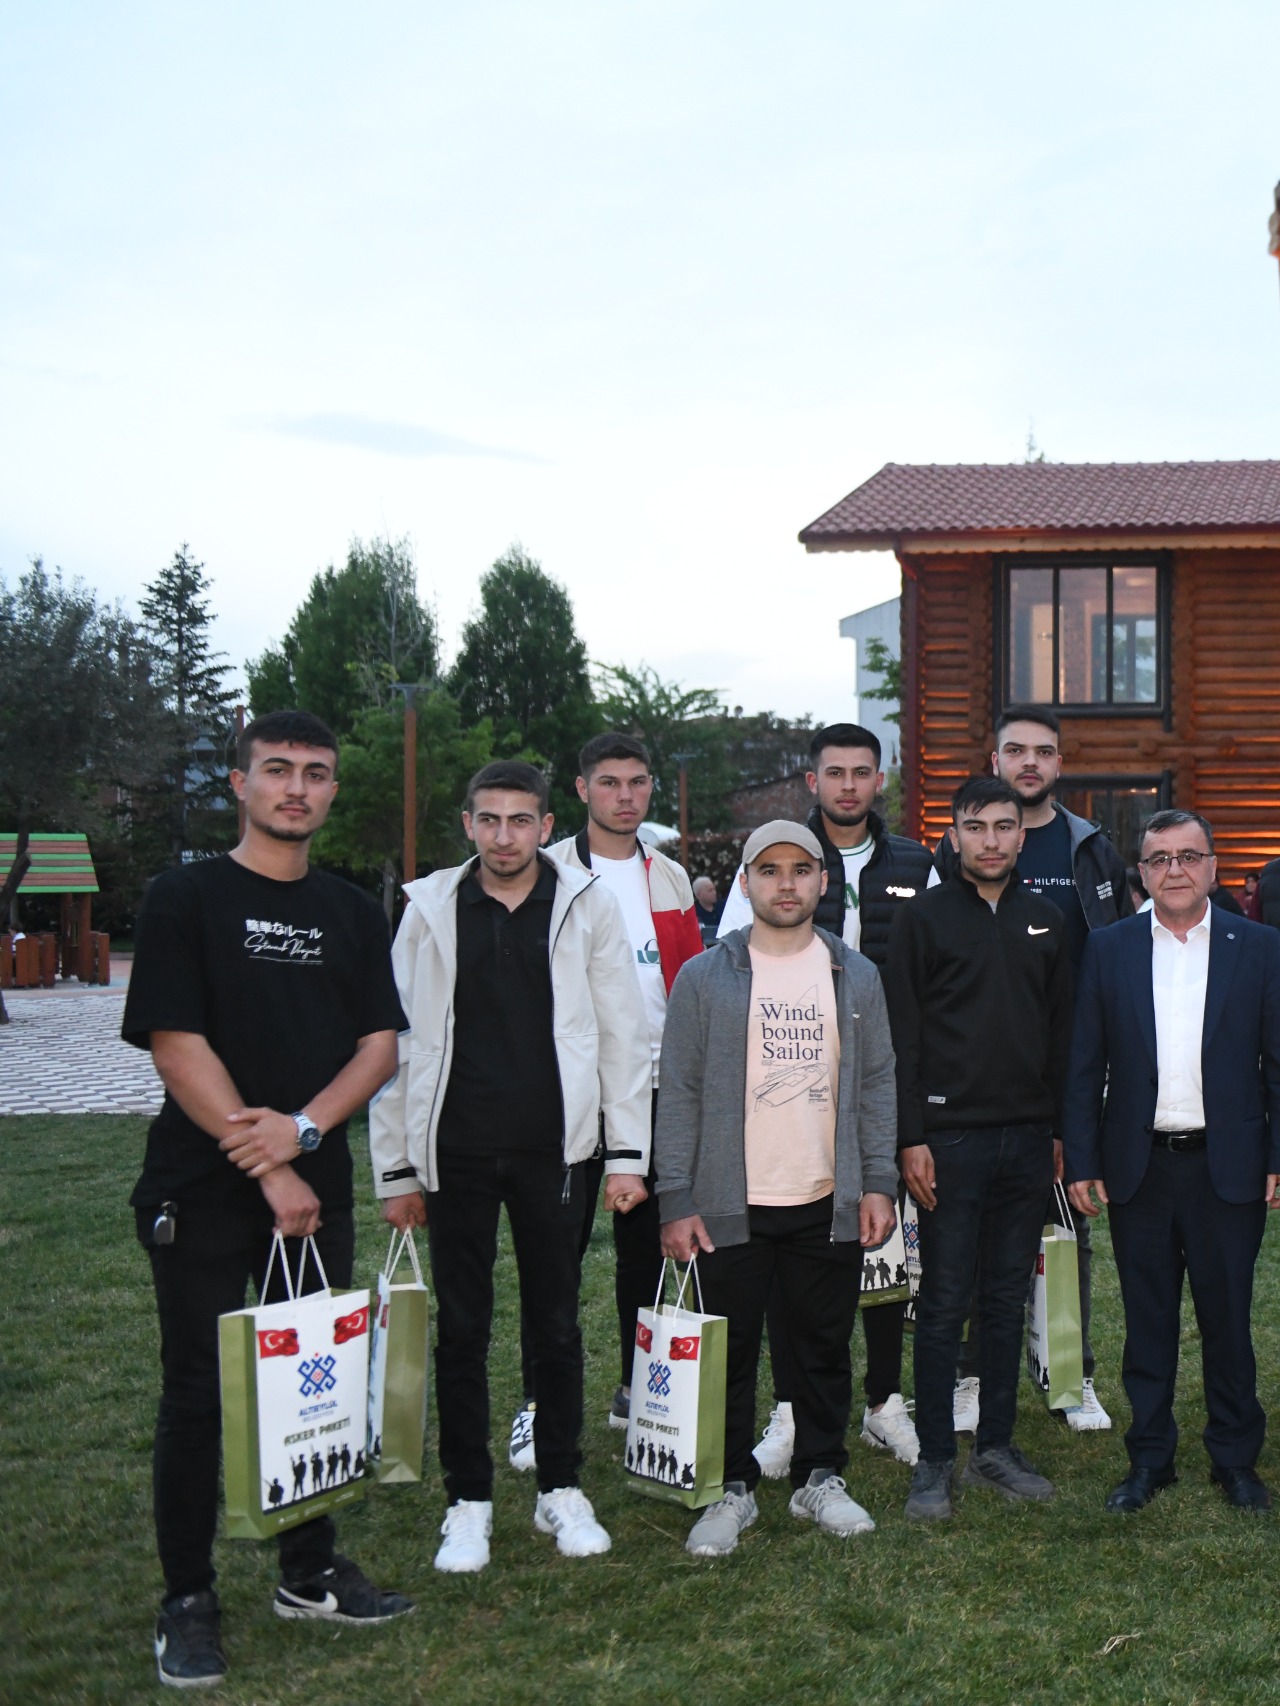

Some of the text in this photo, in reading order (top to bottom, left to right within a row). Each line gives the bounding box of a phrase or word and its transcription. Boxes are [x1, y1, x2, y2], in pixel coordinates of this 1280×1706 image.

[760, 1003, 825, 1021] Wind-
[761, 1022, 824, 1041] bound
[762, 1041, 823, 1061] Sailor
[284, 1428, 316, 1447] ASKER
